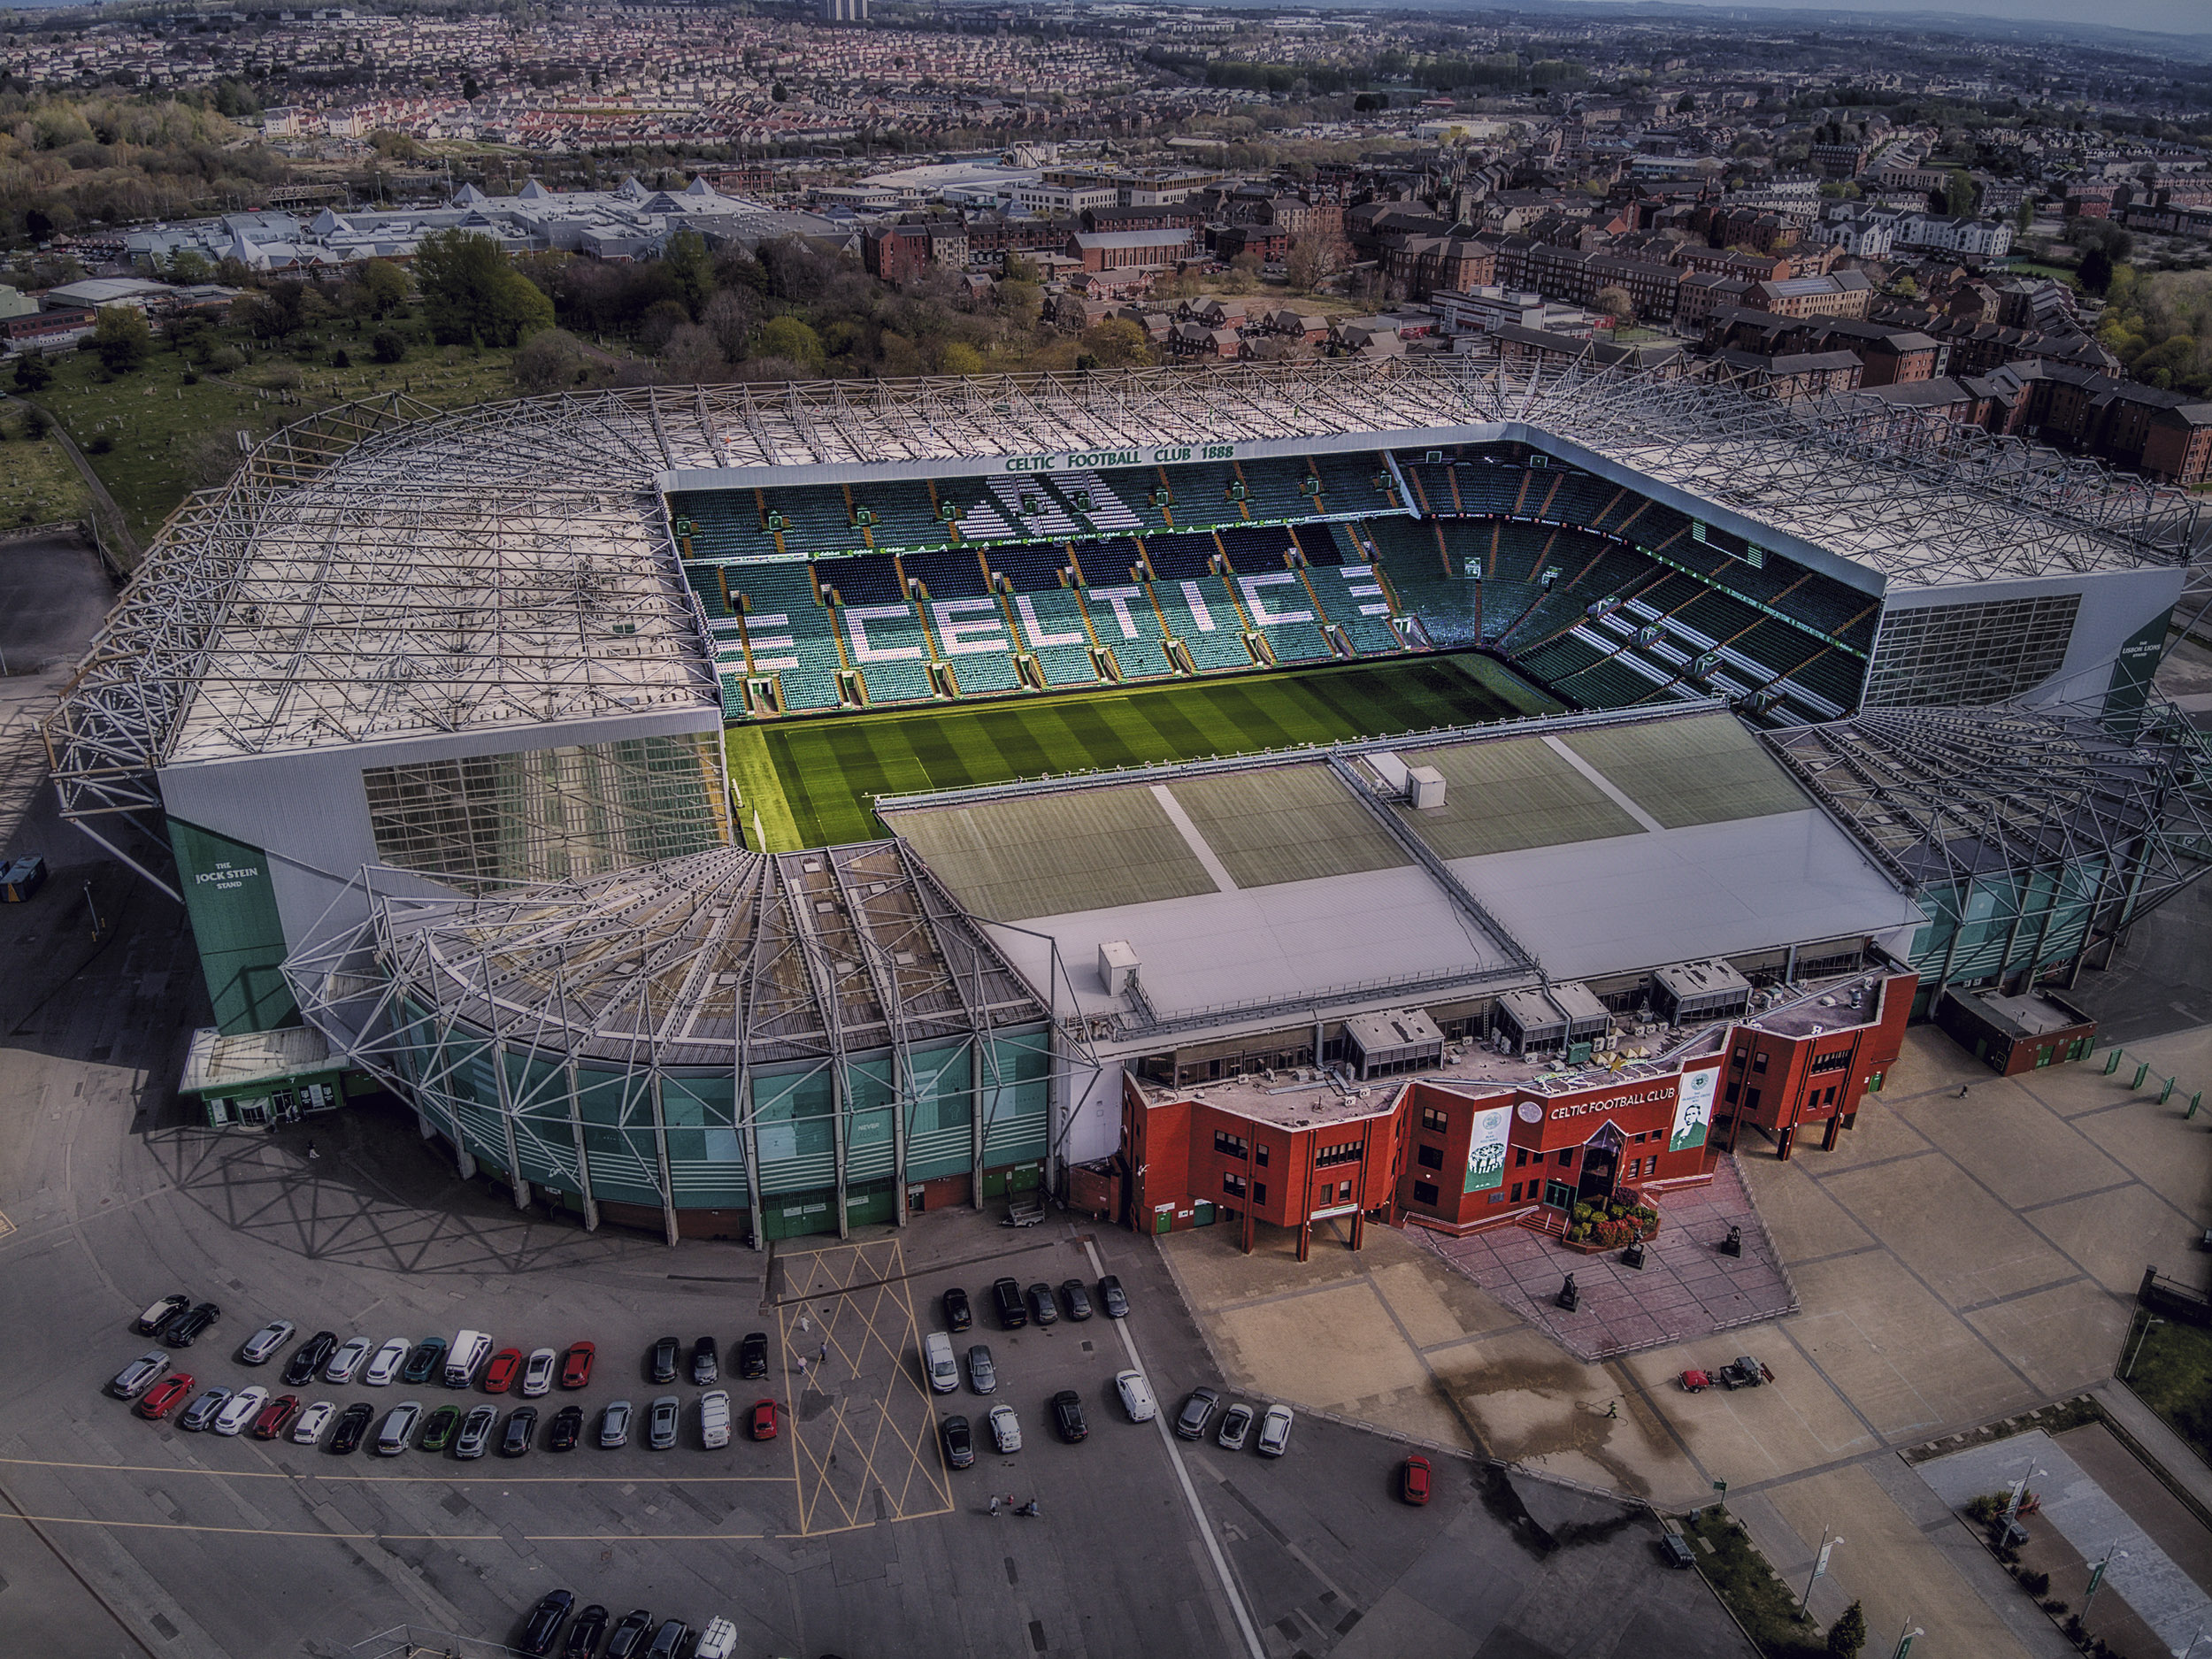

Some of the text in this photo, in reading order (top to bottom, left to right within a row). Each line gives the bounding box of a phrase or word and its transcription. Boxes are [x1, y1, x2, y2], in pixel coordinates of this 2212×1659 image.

[1005, 445, 1233, 472] CELTIC FOOTBALL CLUB 1888
[844, 572, 1314, 663] CELTIC
[196, 868, 258, 885] JOCK STEIN
[1550, 1102, 1589, 1120] CELTIC
[1589, 1094, 1646, 1113] FOOTBALL
[1647, 1087, 1675, 1102] CLUB
